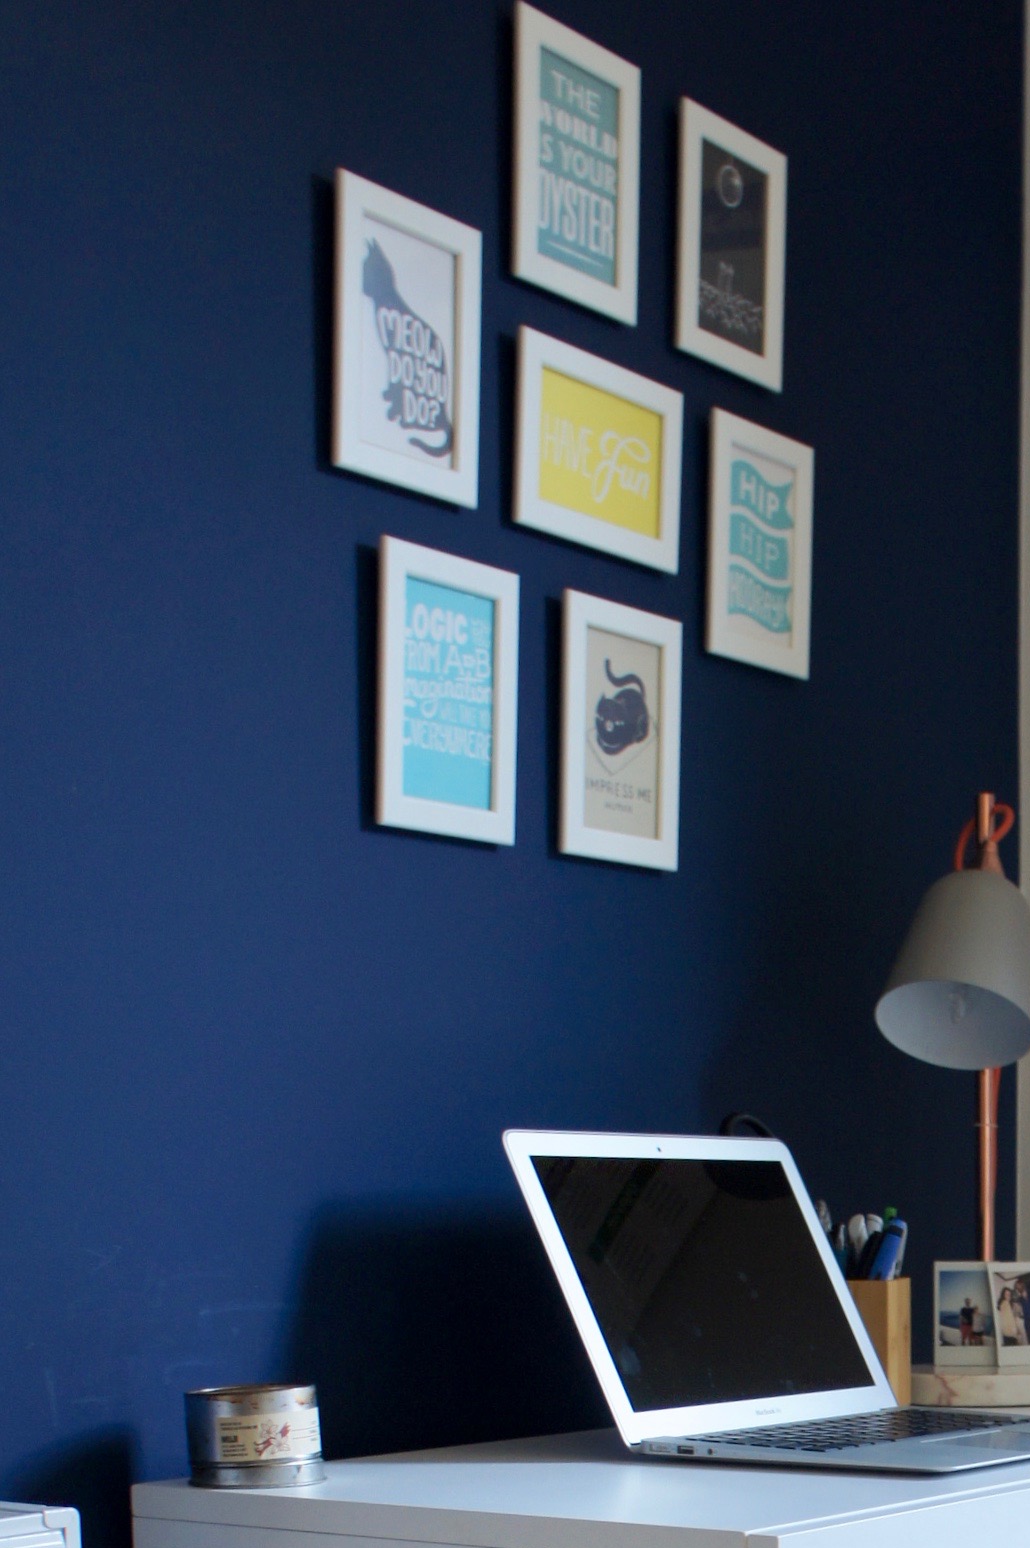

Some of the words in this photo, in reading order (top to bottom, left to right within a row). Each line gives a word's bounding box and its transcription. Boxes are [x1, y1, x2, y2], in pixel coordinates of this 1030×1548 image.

[552, 69, 601, 119] THE
[560, 141, 617, 196] YOUR
[377, 306, 444, 369] MEOW
[388, 350, 414, 387] DO
[414, 358, 448, 404] YOU
[402, 388, 441, 428] DO?
[543, 413, 593, 478] HAVE
[739, 471, 780, 520] HIP
[739, 523, 780, 570] HIP
[443, 645, 465, 676] A
[475, 648, 491, 678] B
